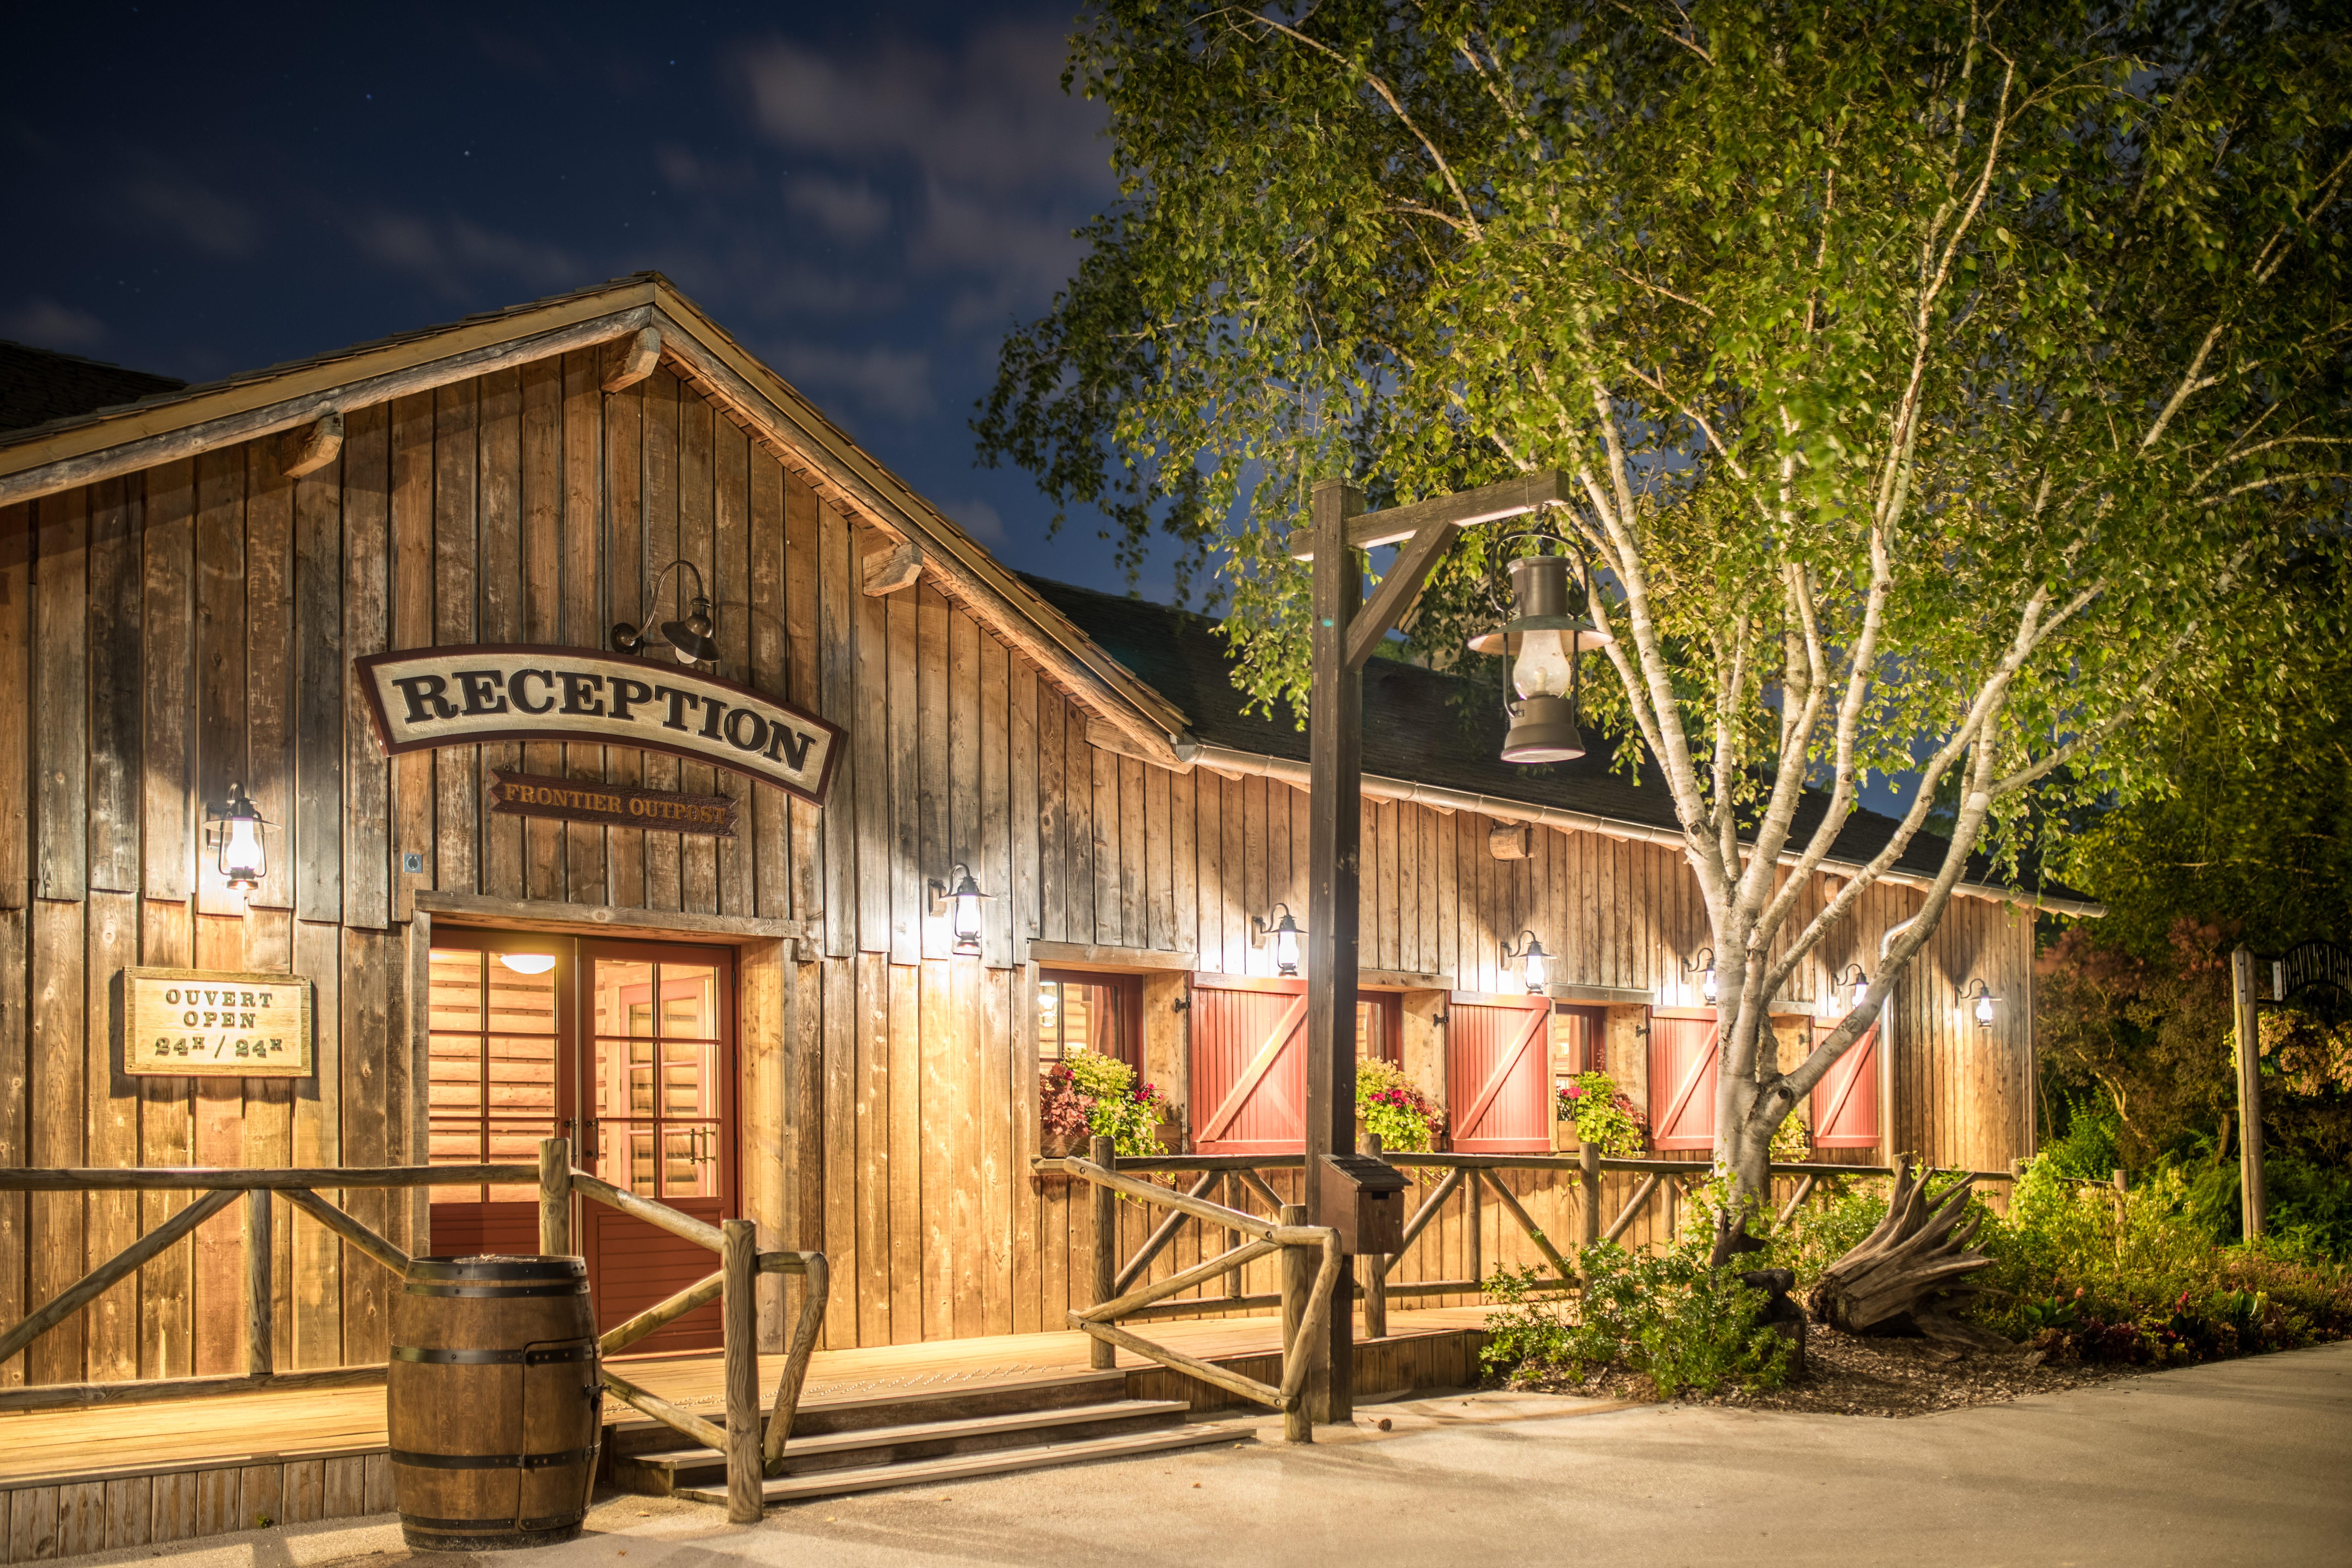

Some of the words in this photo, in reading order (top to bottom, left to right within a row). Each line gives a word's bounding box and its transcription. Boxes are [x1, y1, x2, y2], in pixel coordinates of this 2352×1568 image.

[391, 668, 816, 773] RECEPTION
[503, 783, 622, 814] FRONTIER
[629, 798, 729, 826] OUTPOST
[166, 988, 273, 1008] OUVERT
[184, 1011, 256, 1029] OPEN
